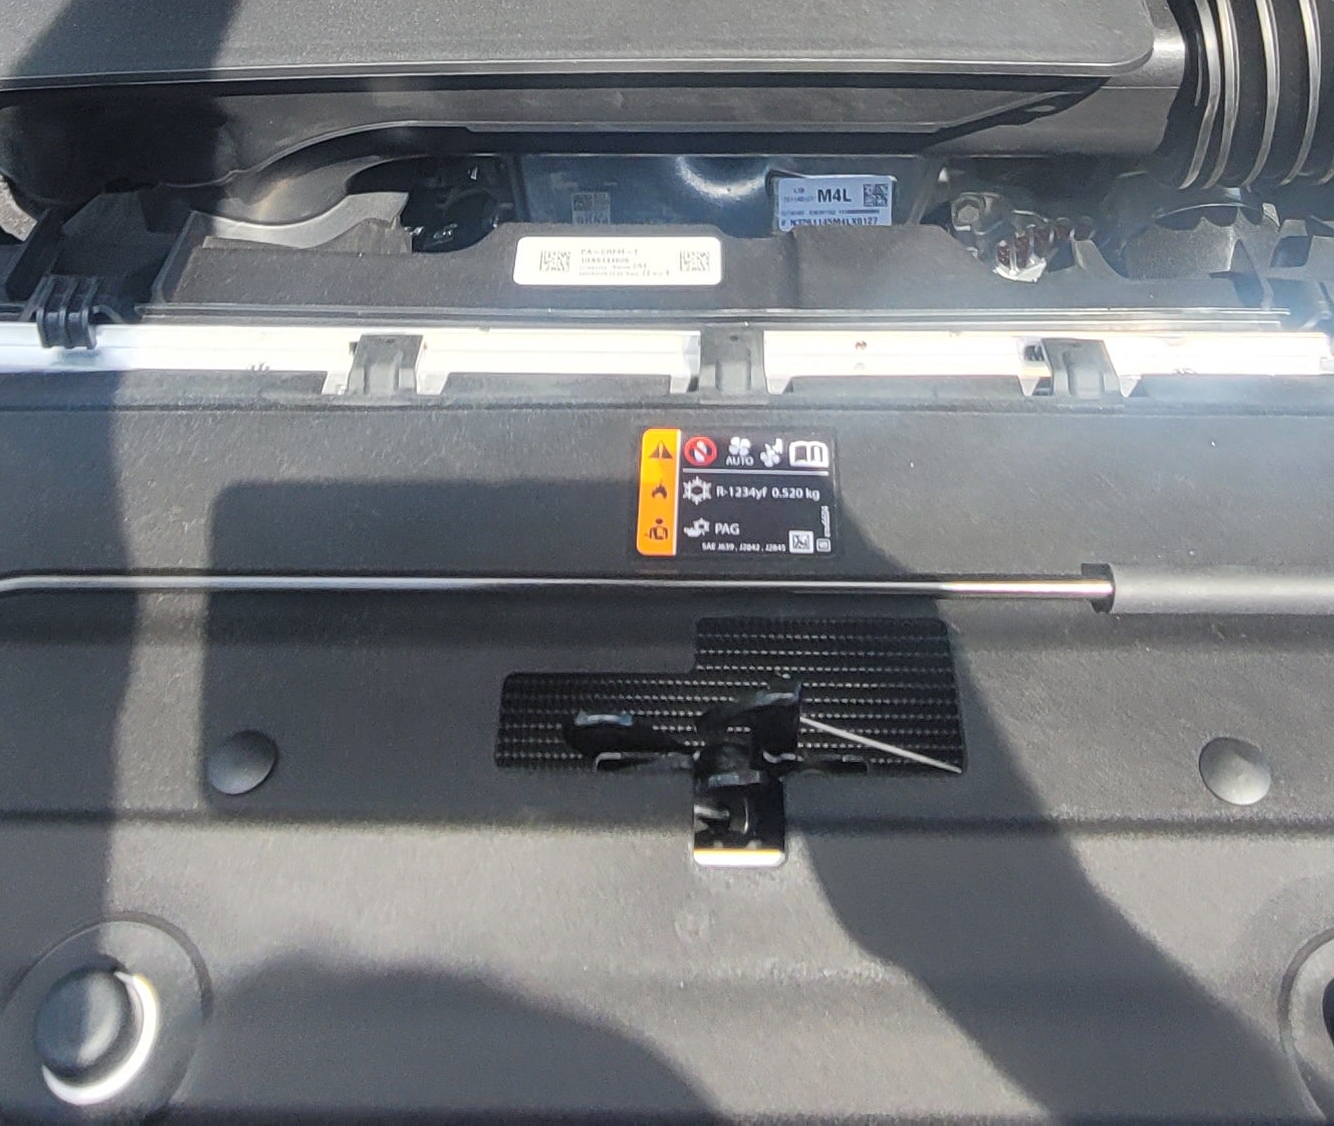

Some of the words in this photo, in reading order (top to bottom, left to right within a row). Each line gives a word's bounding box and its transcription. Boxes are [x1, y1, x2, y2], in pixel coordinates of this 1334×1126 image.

[817, 189, 852, 203] M4L
[726, 456, 754, 466] AUTO
[716, 486, 768, 501] R-1234yf
[772, 487, 803, 499] 0.520
[805, 487, 820, 502] kg
[714, 523, 740, 536] PAG
